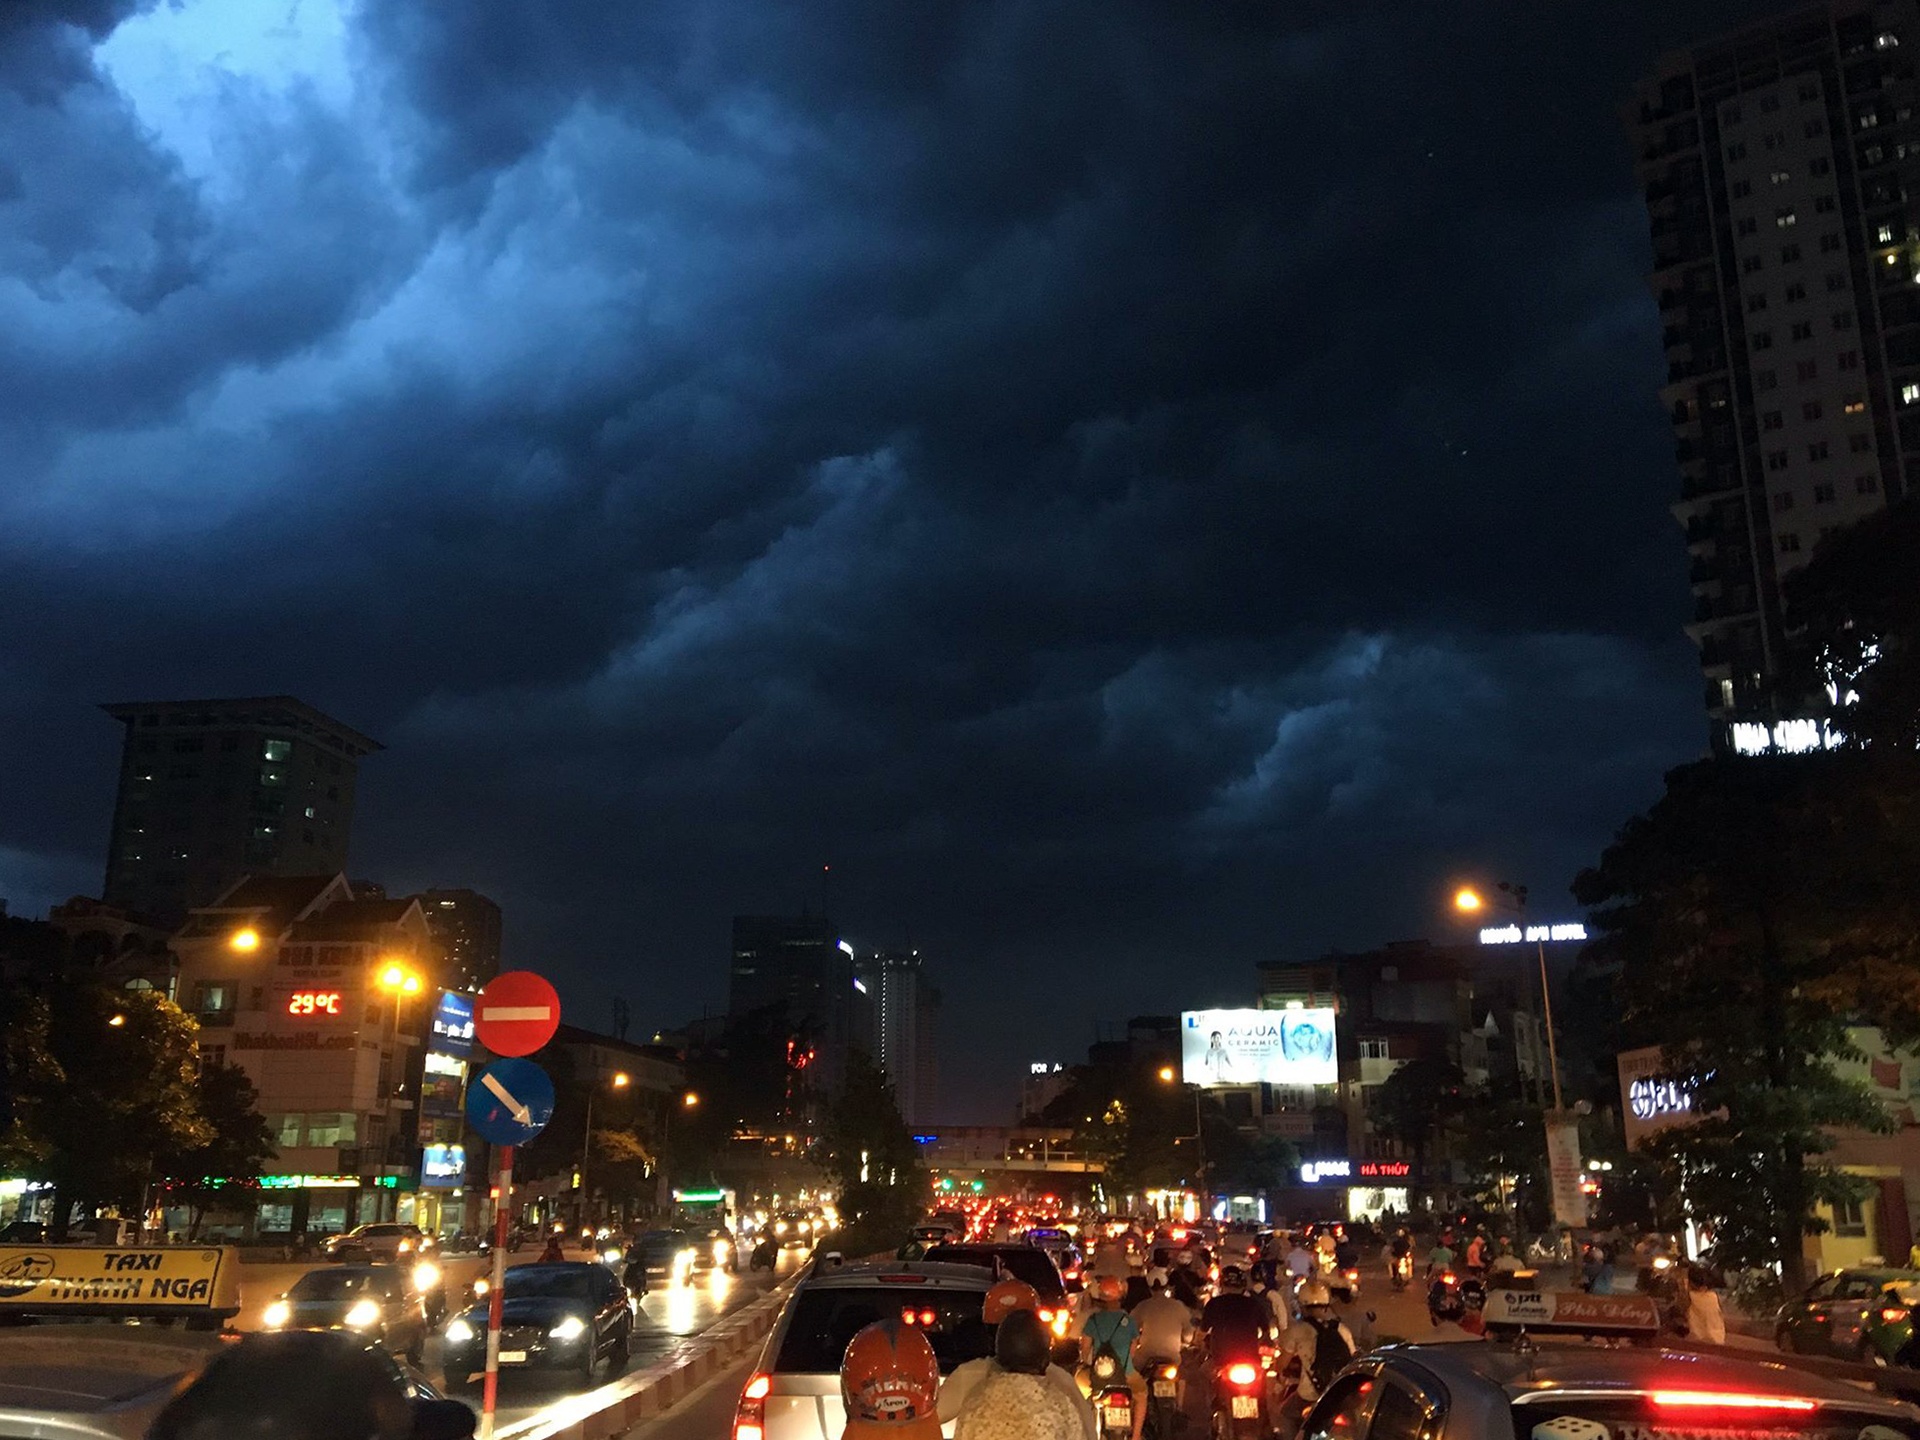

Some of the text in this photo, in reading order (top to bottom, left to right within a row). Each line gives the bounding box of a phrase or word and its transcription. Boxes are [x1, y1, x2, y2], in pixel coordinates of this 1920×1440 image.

[1228, 1025, 1279, 1037] AQUA
[103, 1253, 163, 1271] TAXI
[150, 1278, 209, 1300] NGA
